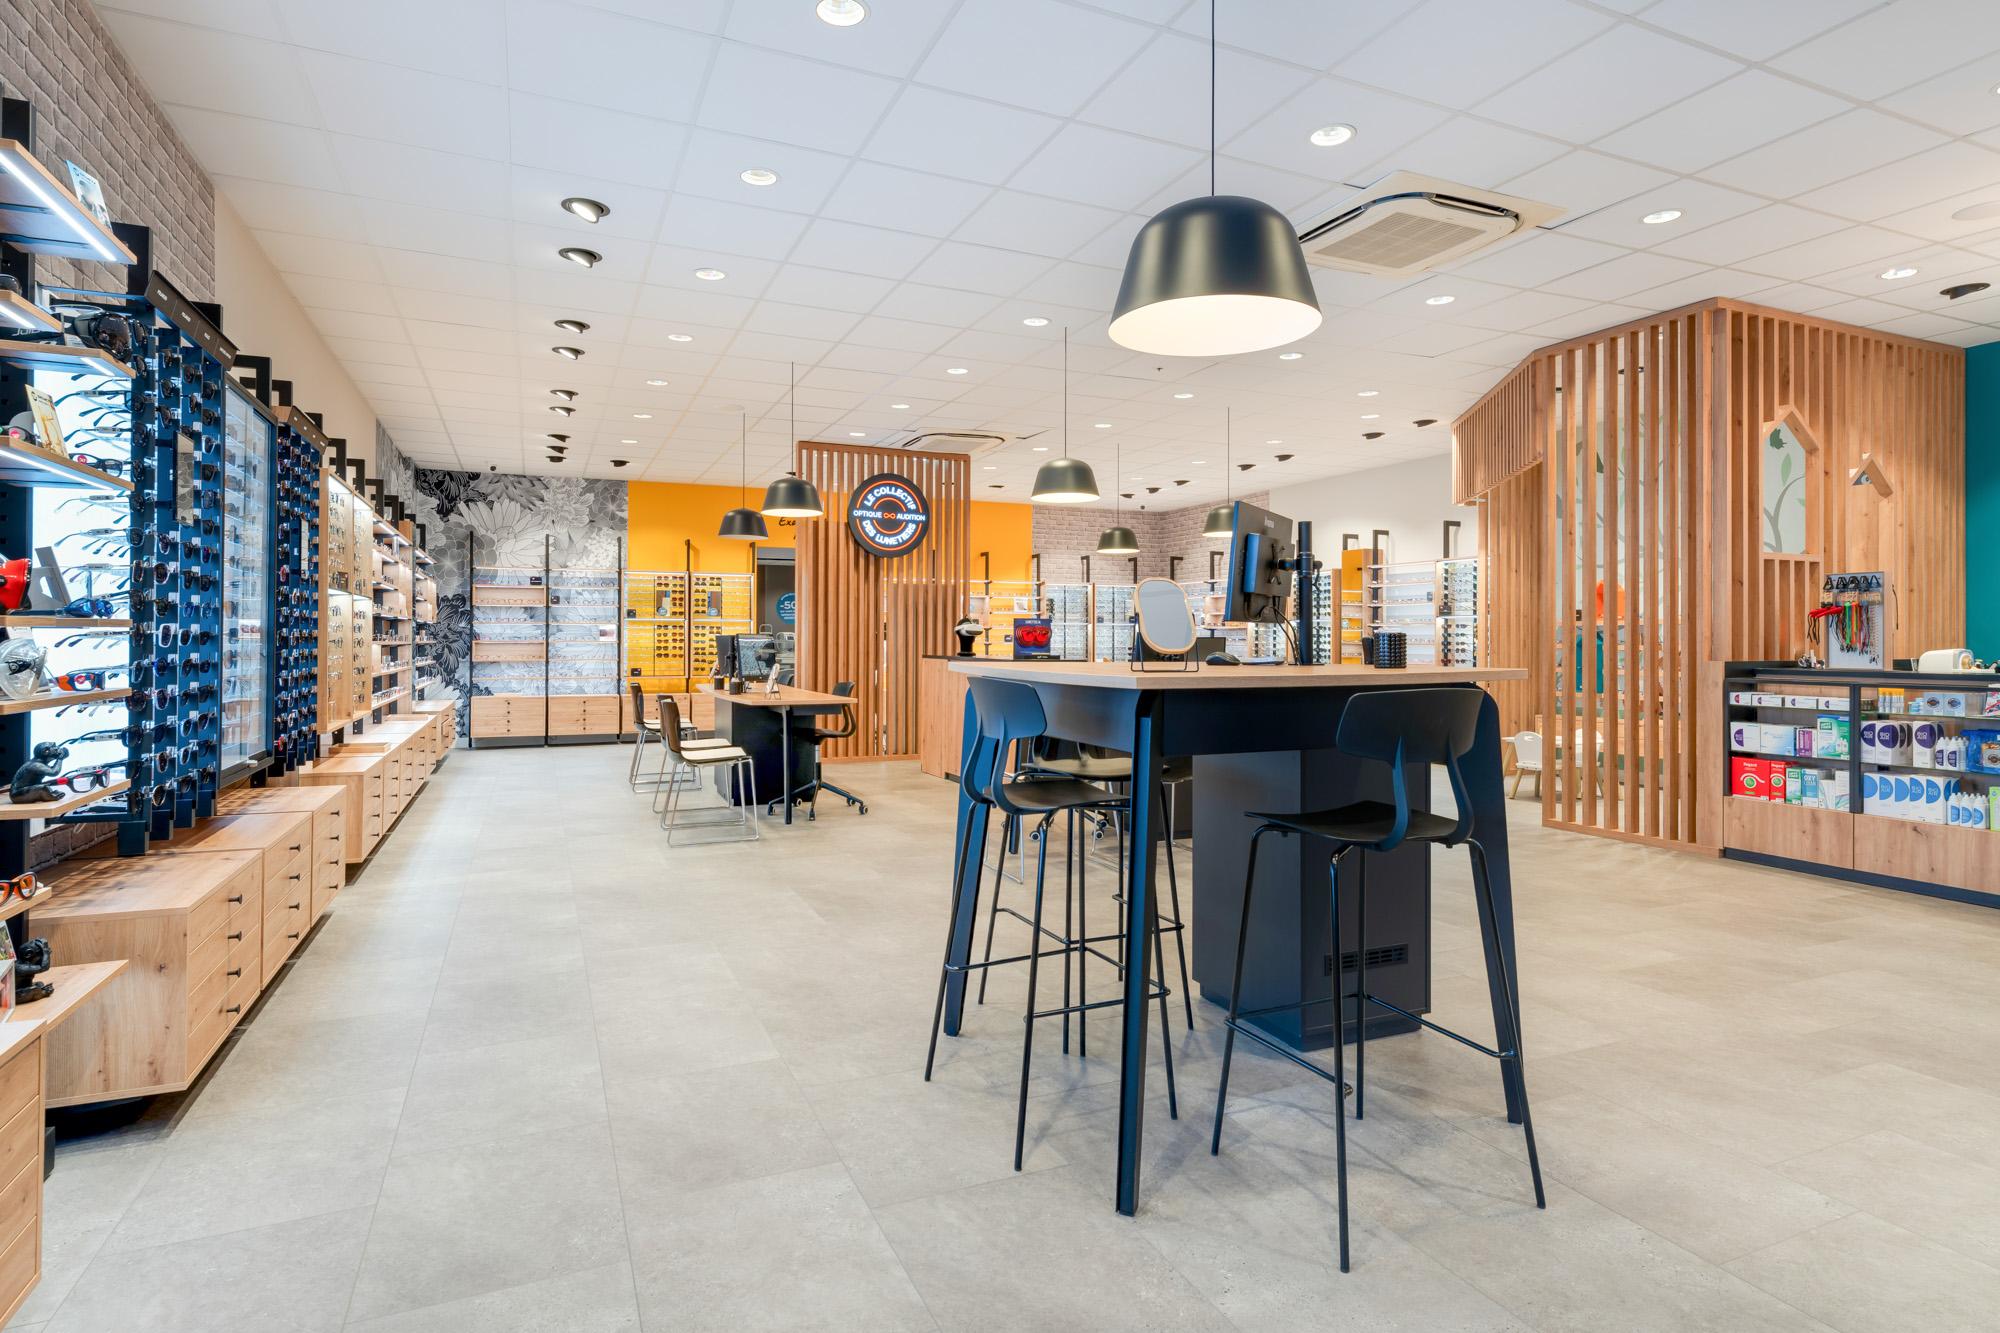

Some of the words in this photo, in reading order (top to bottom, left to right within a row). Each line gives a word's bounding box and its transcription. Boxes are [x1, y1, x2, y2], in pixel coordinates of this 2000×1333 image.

[863, 493, 876, 507] LE
[873, 486, 917, 511] COLLECTIF
[853, 510, 882, 518] OPTIQUE
[896, 513, 926, 521] AUDITION
[862, 519, 877, 537] DES
